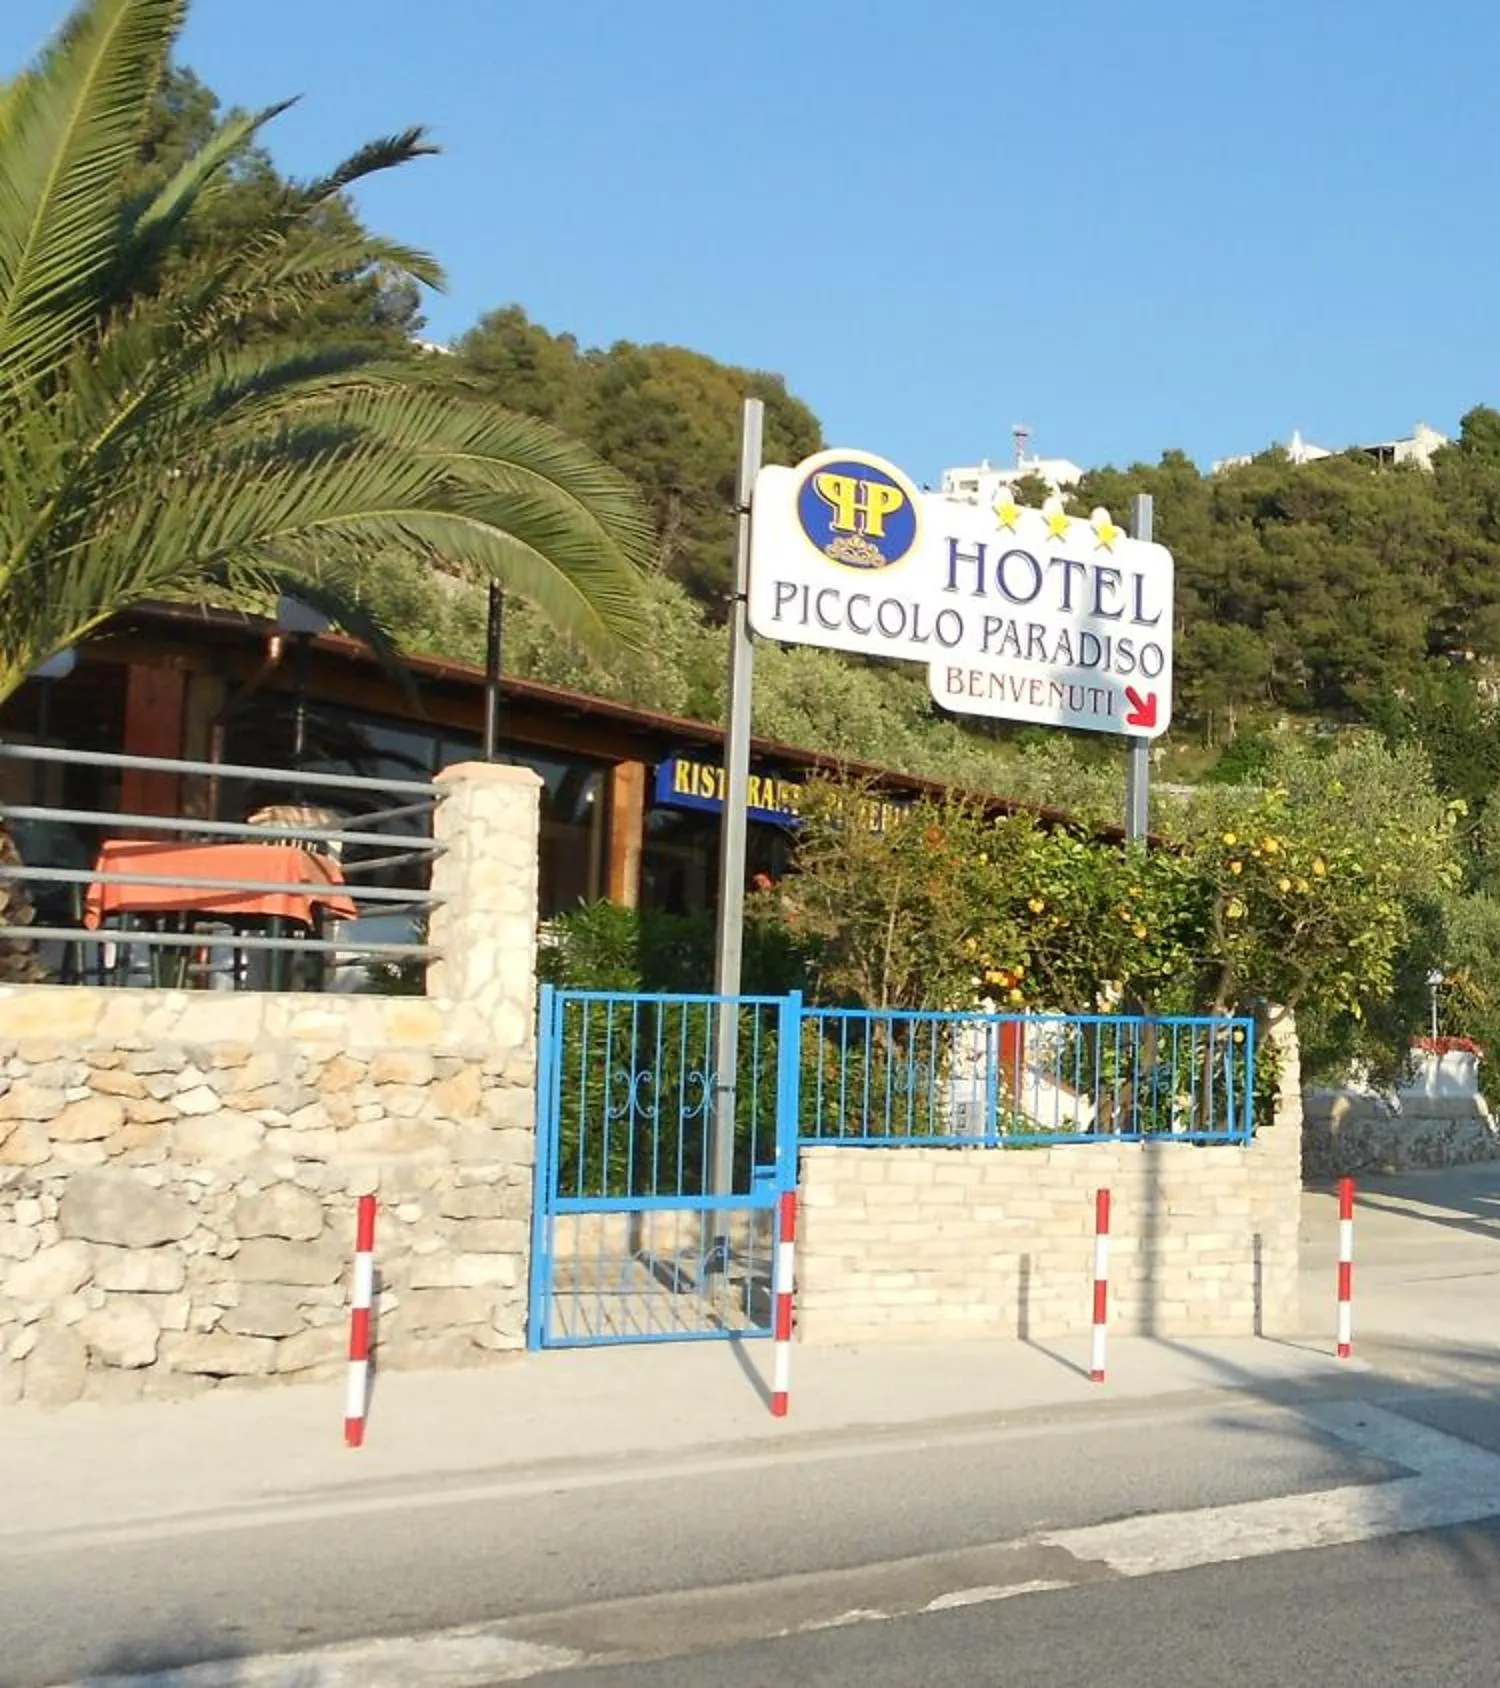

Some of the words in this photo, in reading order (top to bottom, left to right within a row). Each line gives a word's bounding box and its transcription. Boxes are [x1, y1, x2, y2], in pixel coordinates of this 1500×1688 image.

[943, 536, 1163, 627] HOTEL
[771, 579, 965, 648] PICCOLO
[979, 614, 1166, 679] PARADISO
[946, 666, 1115, 717] BENVENUTI
